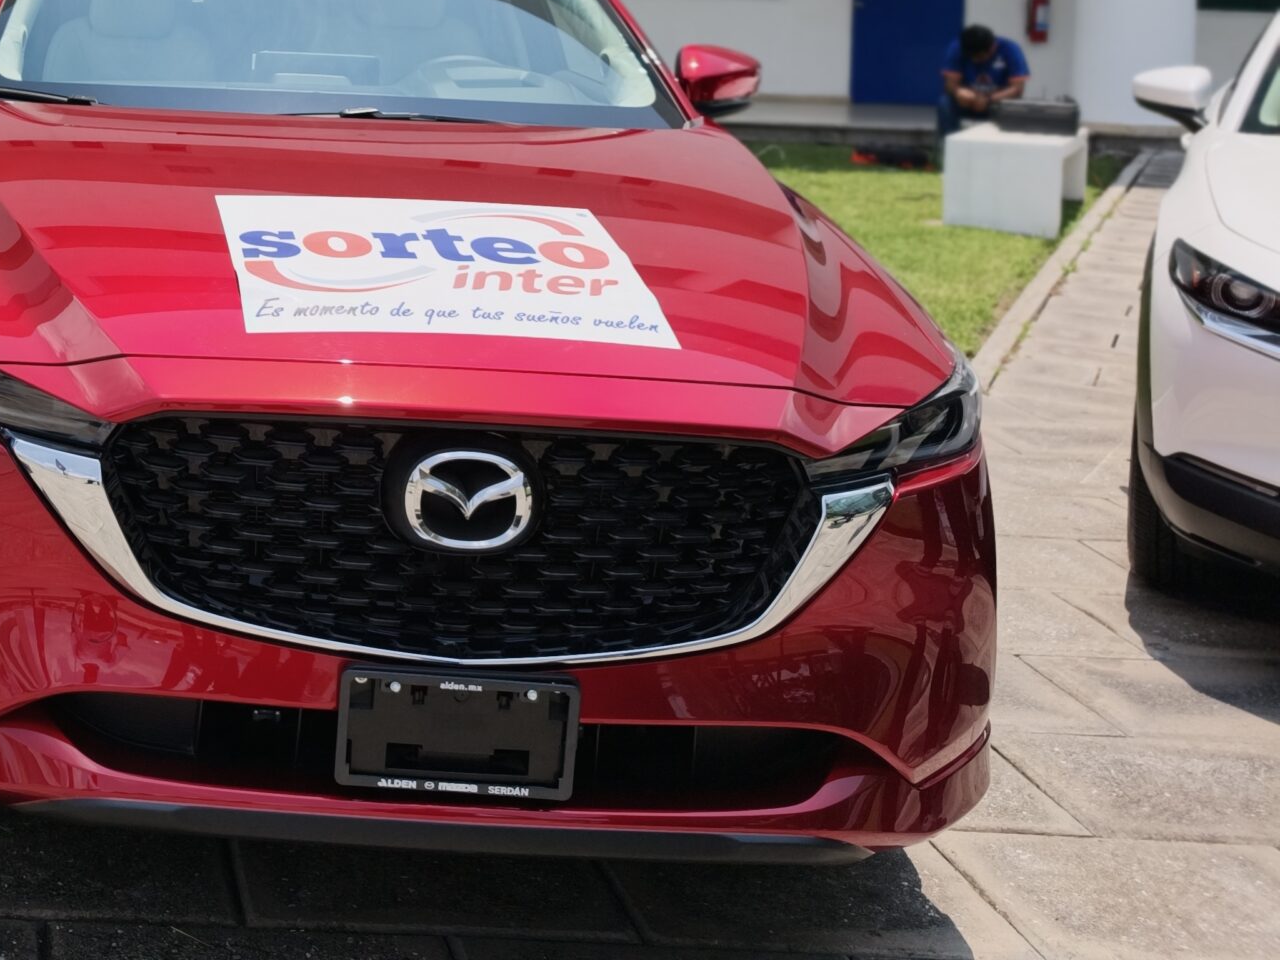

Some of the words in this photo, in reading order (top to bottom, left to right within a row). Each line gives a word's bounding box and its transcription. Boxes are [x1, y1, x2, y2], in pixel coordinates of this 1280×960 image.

[239, 228, 610, 270] sorteo
[452, 264, 619, 297] inter
[255, 297, 284, 318] Es
[293, 301, 380, 318] momento
[390, 301, 414, 318] de
[424, 308, 460, 326] que
[471, 306, 505, 322] tus
[514, 310, 582, 326] sueños
[593, 314, 659, 333] vuelen
[440, 681, 483, 692] alden.mx
[377, 778, 417, 789] ALDEN
